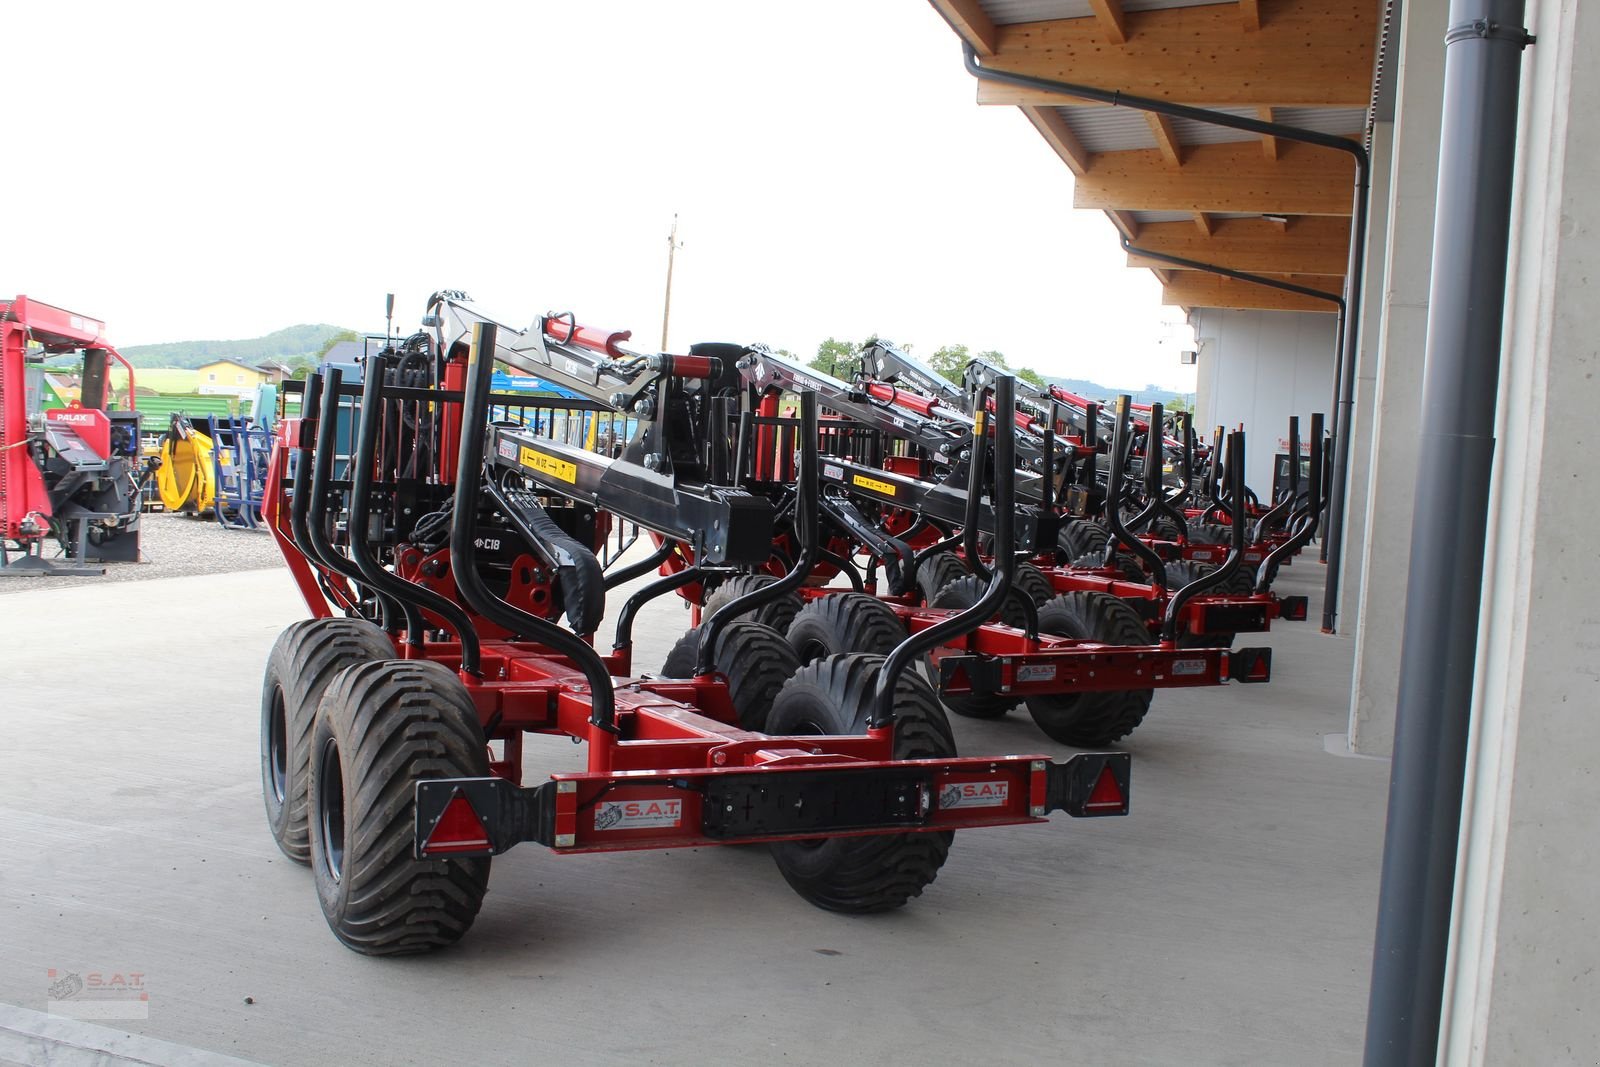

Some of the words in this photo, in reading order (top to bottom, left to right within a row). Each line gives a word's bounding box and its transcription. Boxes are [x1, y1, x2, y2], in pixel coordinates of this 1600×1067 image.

[57, 413, 87, 422] PALAX
[484, 538, 500, 550] C18
[963, 783, 1006, 797] S.A.T.
[625, 801, 679, 817] S.A.T.
